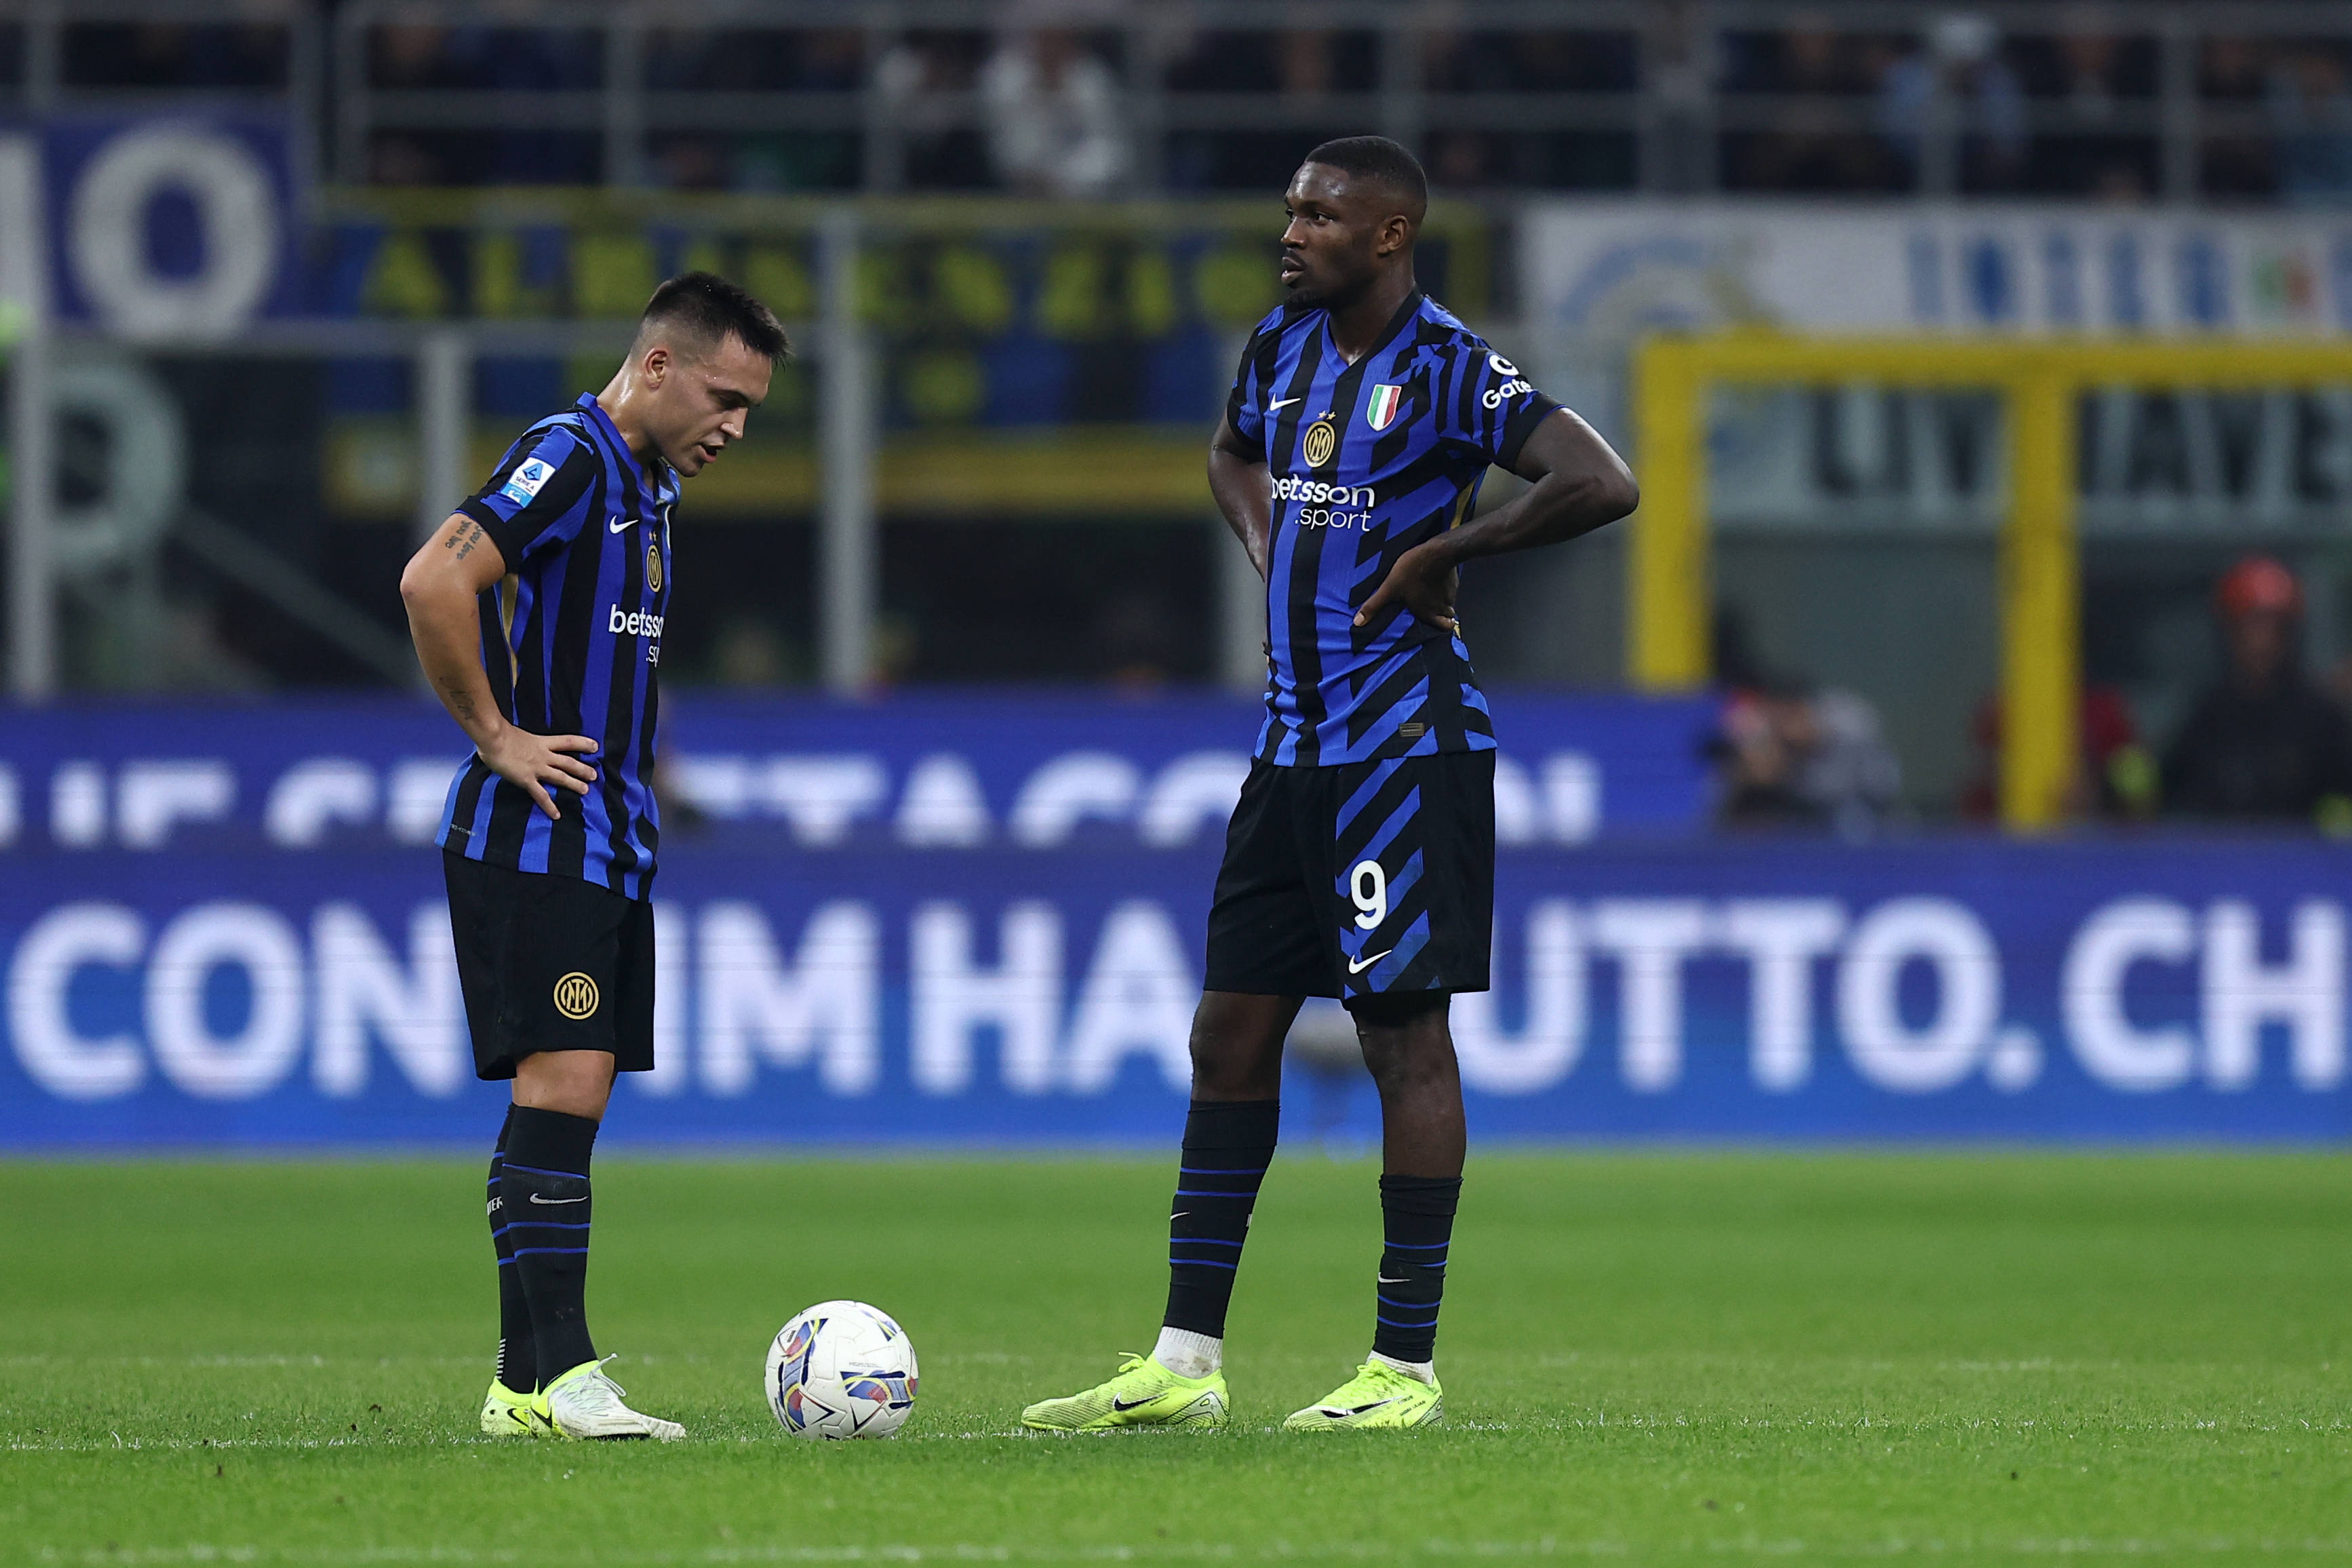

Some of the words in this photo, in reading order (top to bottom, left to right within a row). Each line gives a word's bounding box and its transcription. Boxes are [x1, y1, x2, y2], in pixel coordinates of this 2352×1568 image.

[1268, 471, 1375, 507] betsson
[608, 604, 664, 638] betsso
[1350, 860, 1387, 930] 9
[7, 899, 471, 1100] CON
[629, 899, 882, 1099] IM
[1448, 897, 2043, 1096] UTTO.
[2059, 897, 2351, 1096] CH
